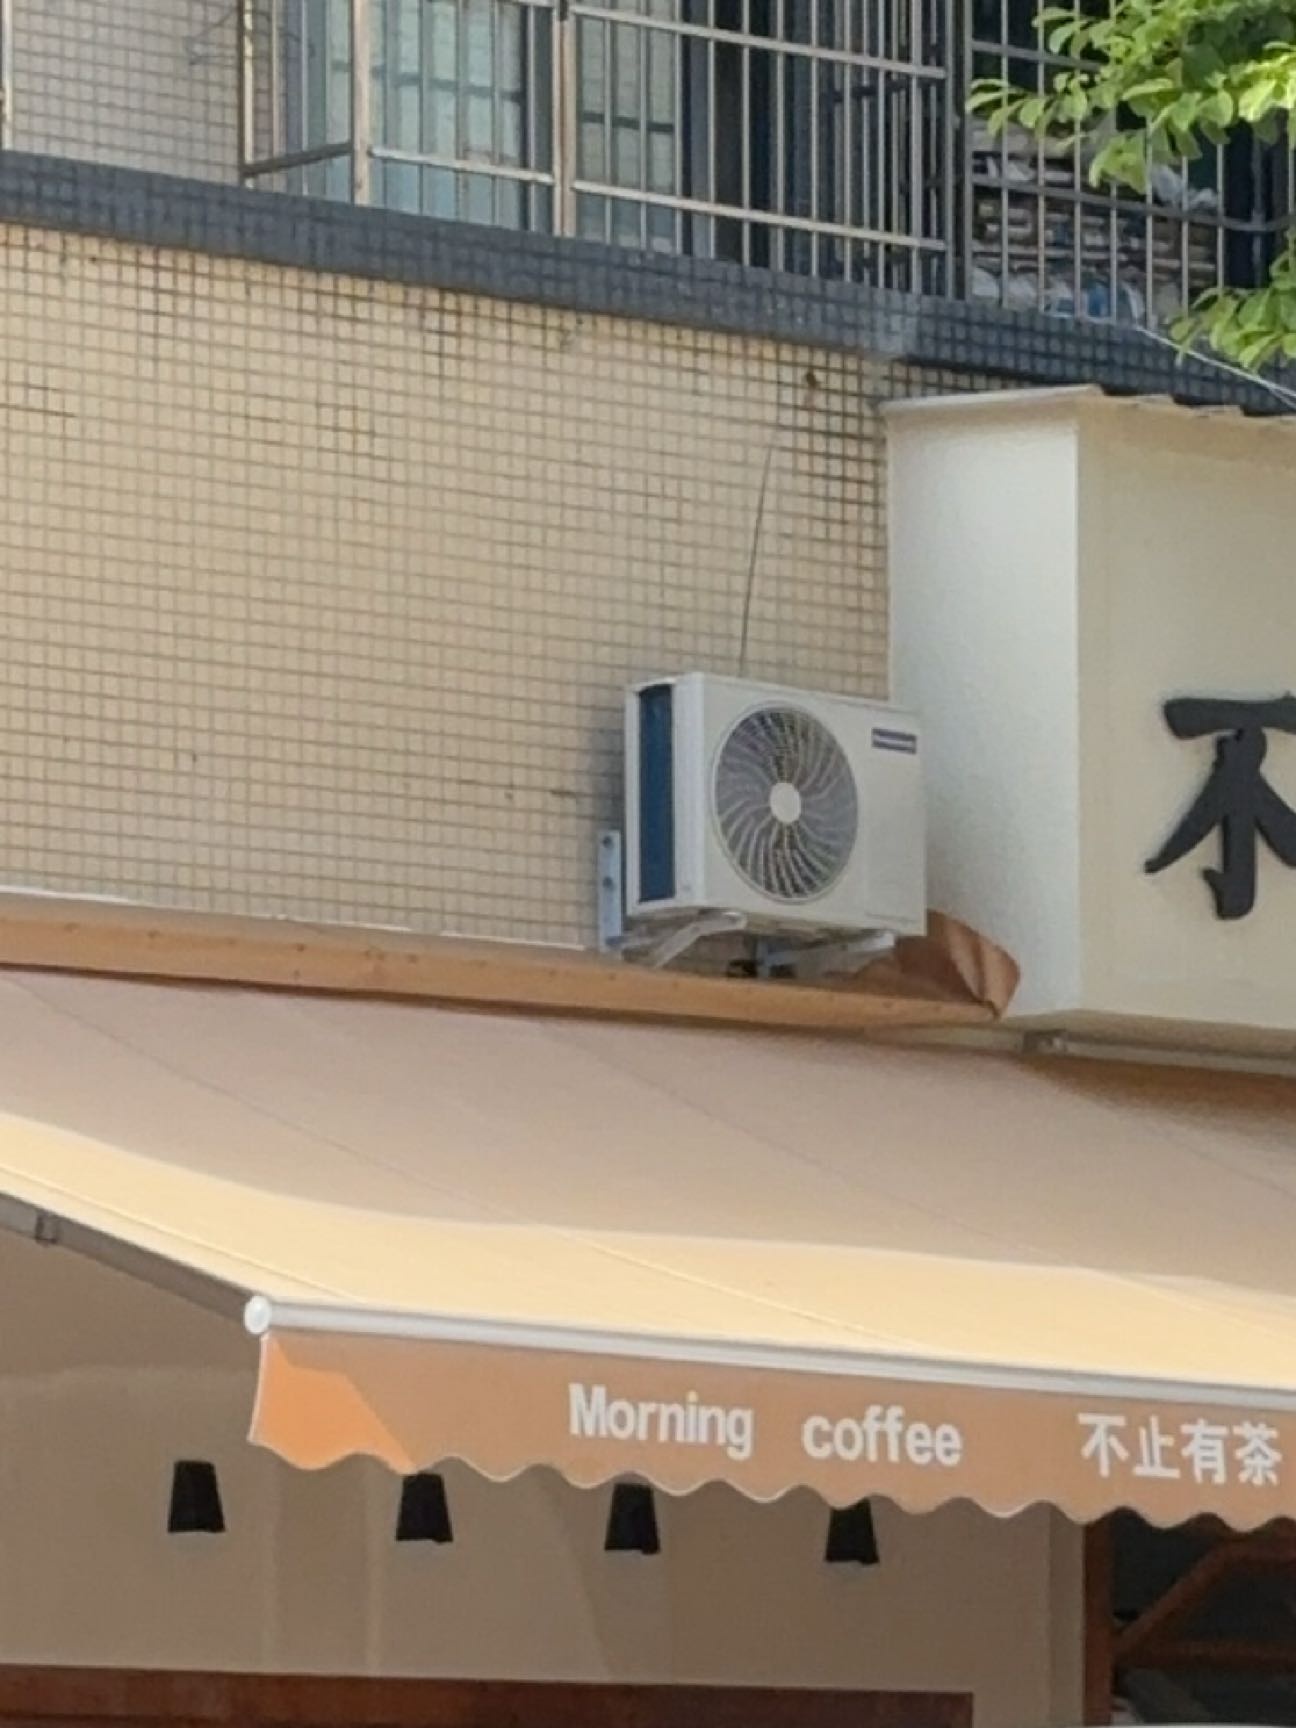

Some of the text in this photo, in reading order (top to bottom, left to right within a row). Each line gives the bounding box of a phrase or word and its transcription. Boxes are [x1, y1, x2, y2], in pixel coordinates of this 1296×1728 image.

[568, 1382, 962, 1466] Morning coffee
[1077, 1412, 1284, 1487] 不止有茶
